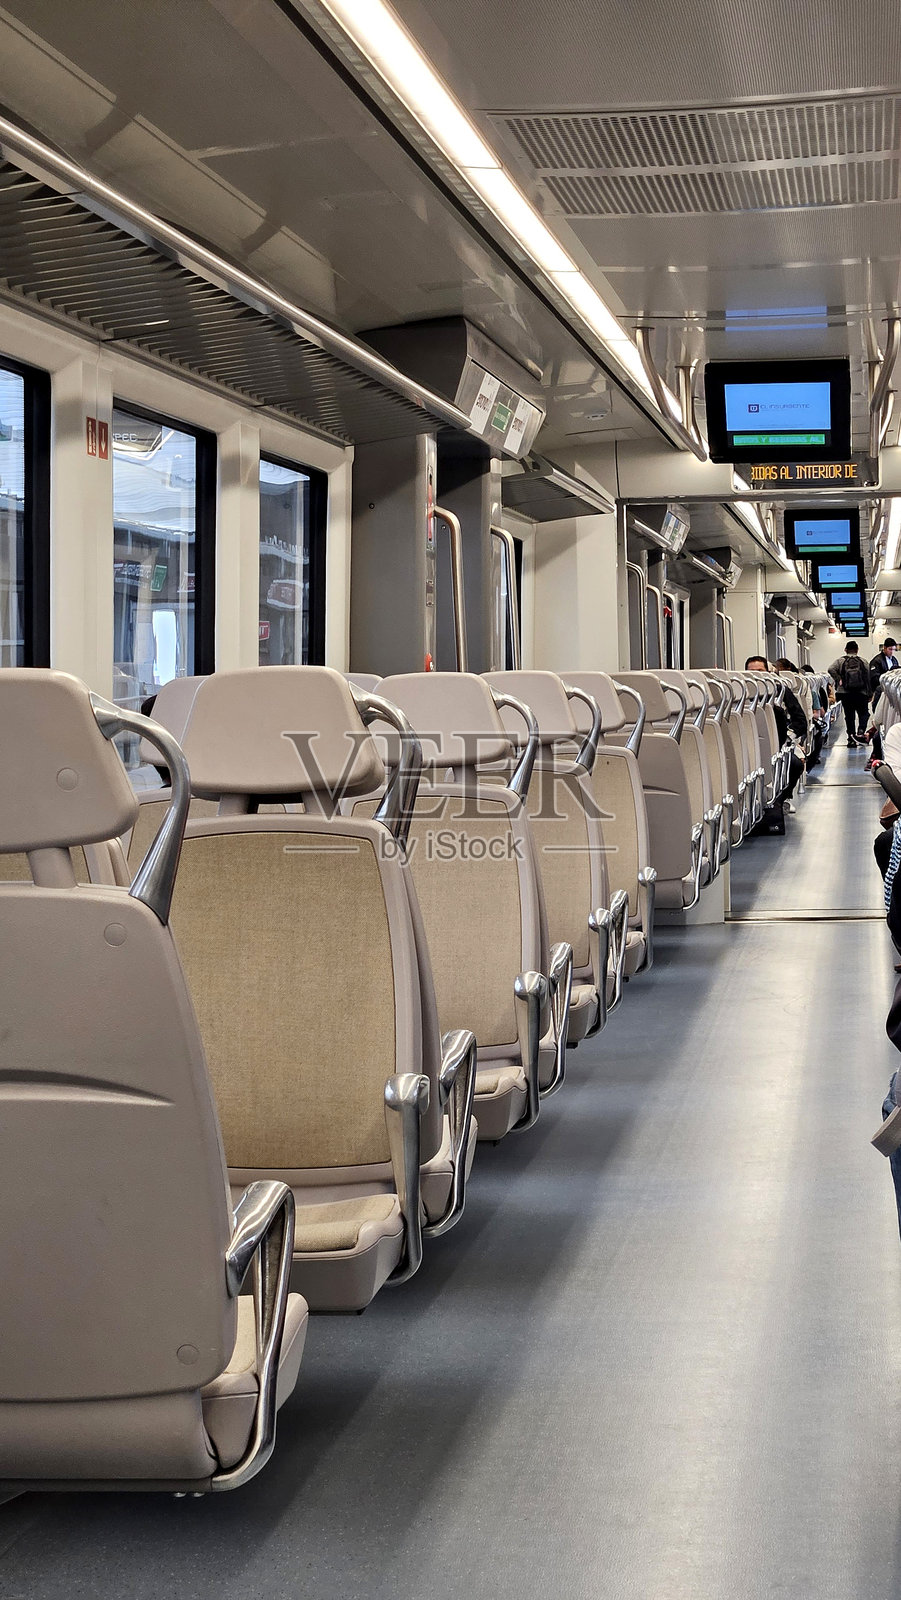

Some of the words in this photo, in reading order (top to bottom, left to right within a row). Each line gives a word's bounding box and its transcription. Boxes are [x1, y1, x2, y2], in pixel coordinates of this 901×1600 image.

[780, 465, 793, 480] AL
[796, 464, 842, 479] INTERIOR
[845, 464, 857, 478] DE
